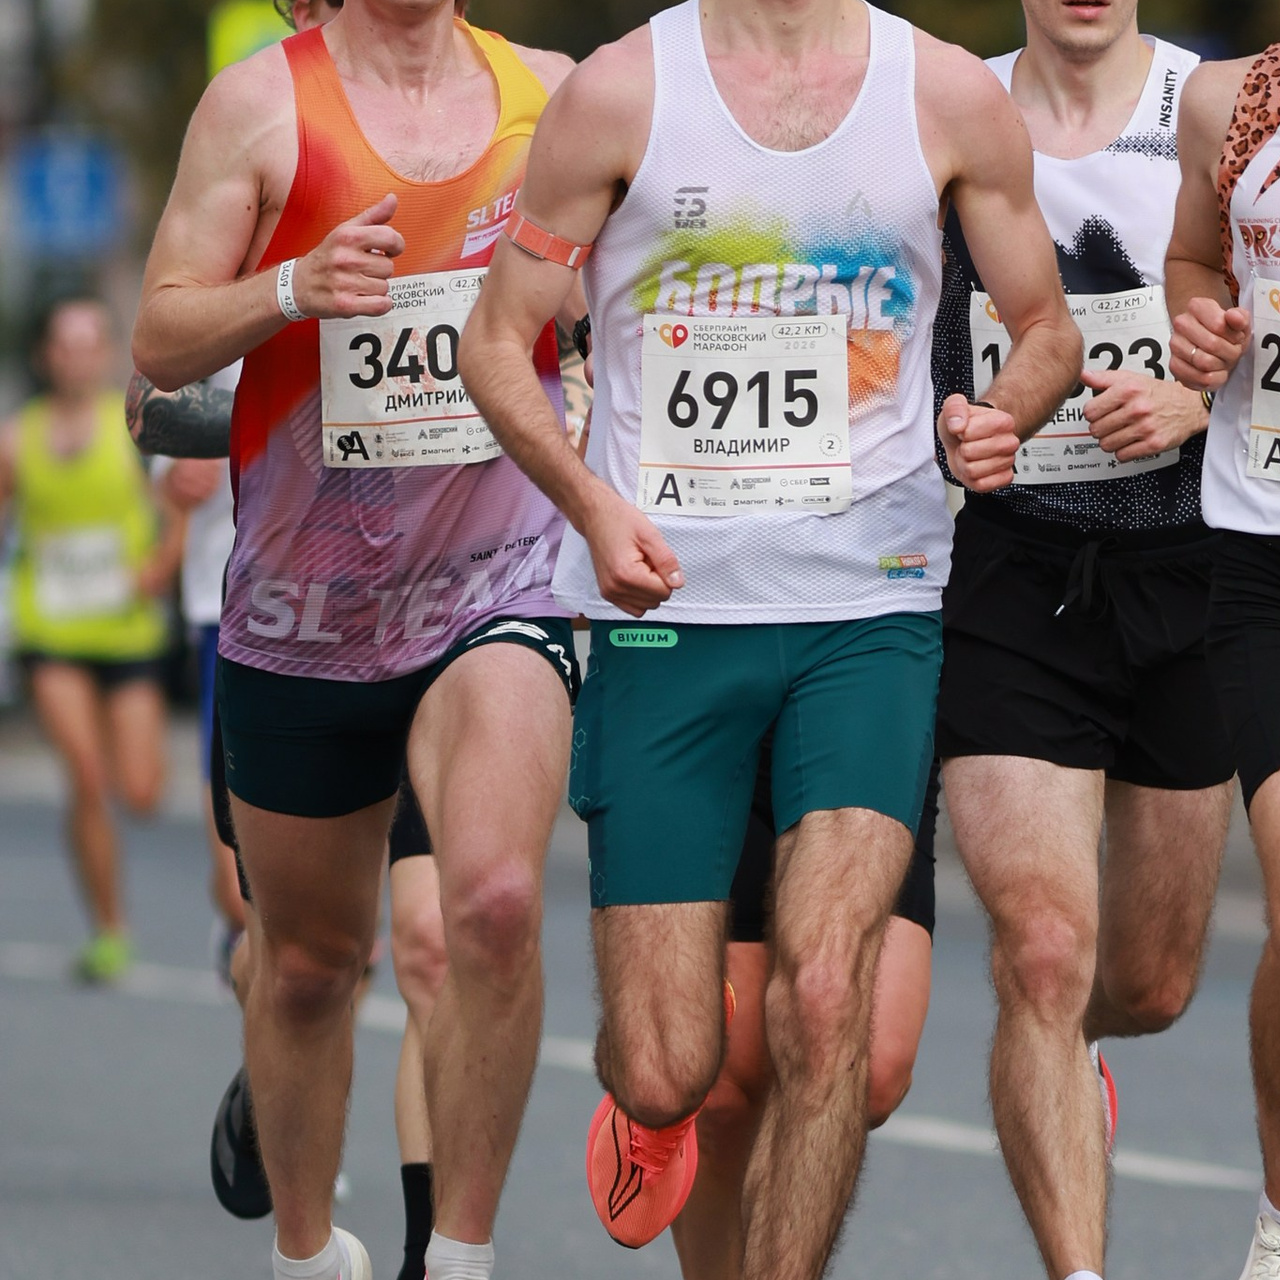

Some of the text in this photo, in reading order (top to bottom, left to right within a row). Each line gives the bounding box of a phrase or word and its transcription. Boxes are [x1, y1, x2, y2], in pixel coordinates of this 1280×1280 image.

[1159, 69, 1177, 127] INSANITY
[280, 263, 291, 287] 3409
[390, 286, 444, 301] СКОВСКИЙ
[391, 299, 426, 310] РАФОН
[1097, 300, 1120, 310] 42,2
[693, 324, 747, 332] СБЕРПРАЙМ
[778, 326, 801, 336] 42,2
[693, 332, 766, 342] МОСКОВСКИЙ
[693, 342, 747, 352] МАРАФОН
[348, 324, 460, 389] 340
[385, 386, 470, 413] ДМИТРИЙ
[667, 370, 818, 429] 6915
[693, 438, 790, 457] ВЛАДИМИР
[827, 440, 835, 450] 2
[247, 579, 343, 644] SL
[617, 633, 669, 643] BIVIUM
